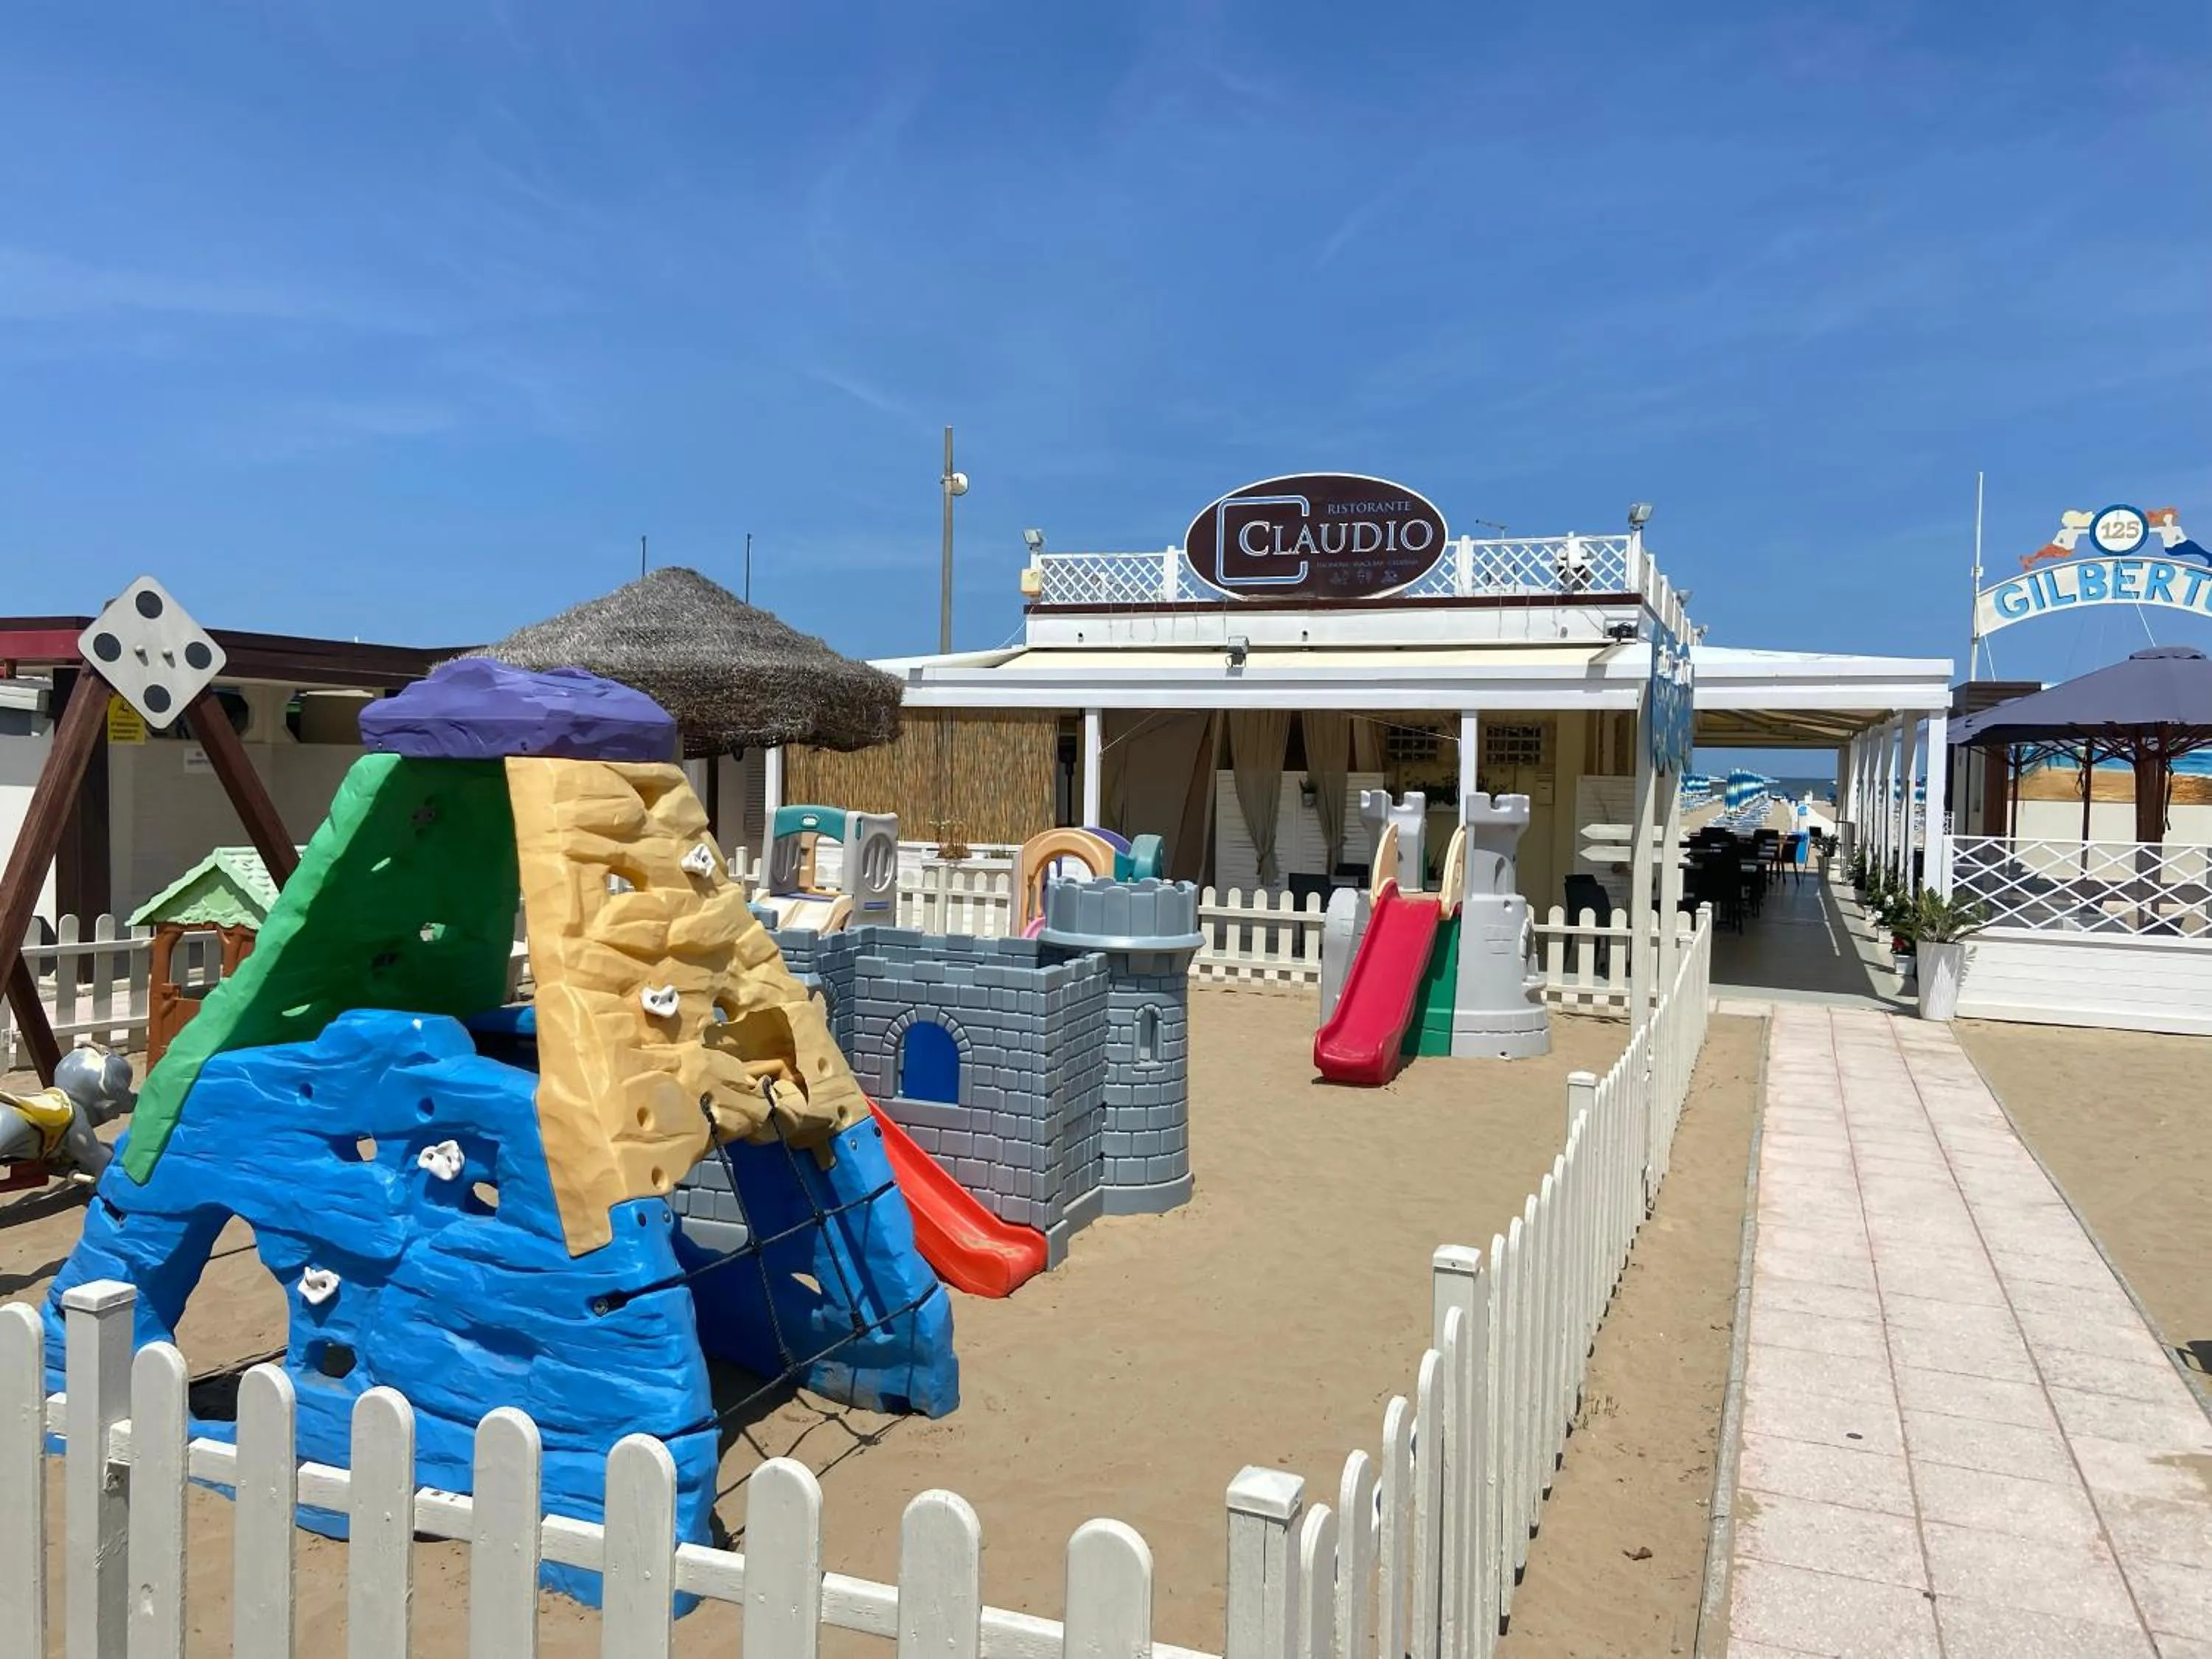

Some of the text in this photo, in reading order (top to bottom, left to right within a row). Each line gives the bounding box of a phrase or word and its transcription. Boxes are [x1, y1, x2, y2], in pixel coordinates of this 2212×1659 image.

[1327, 501, 1411, 515] RISTORANTE
[1239, 518, 1434, 557] CLAUDIO
[2101, 521, 2140, 539] 125
